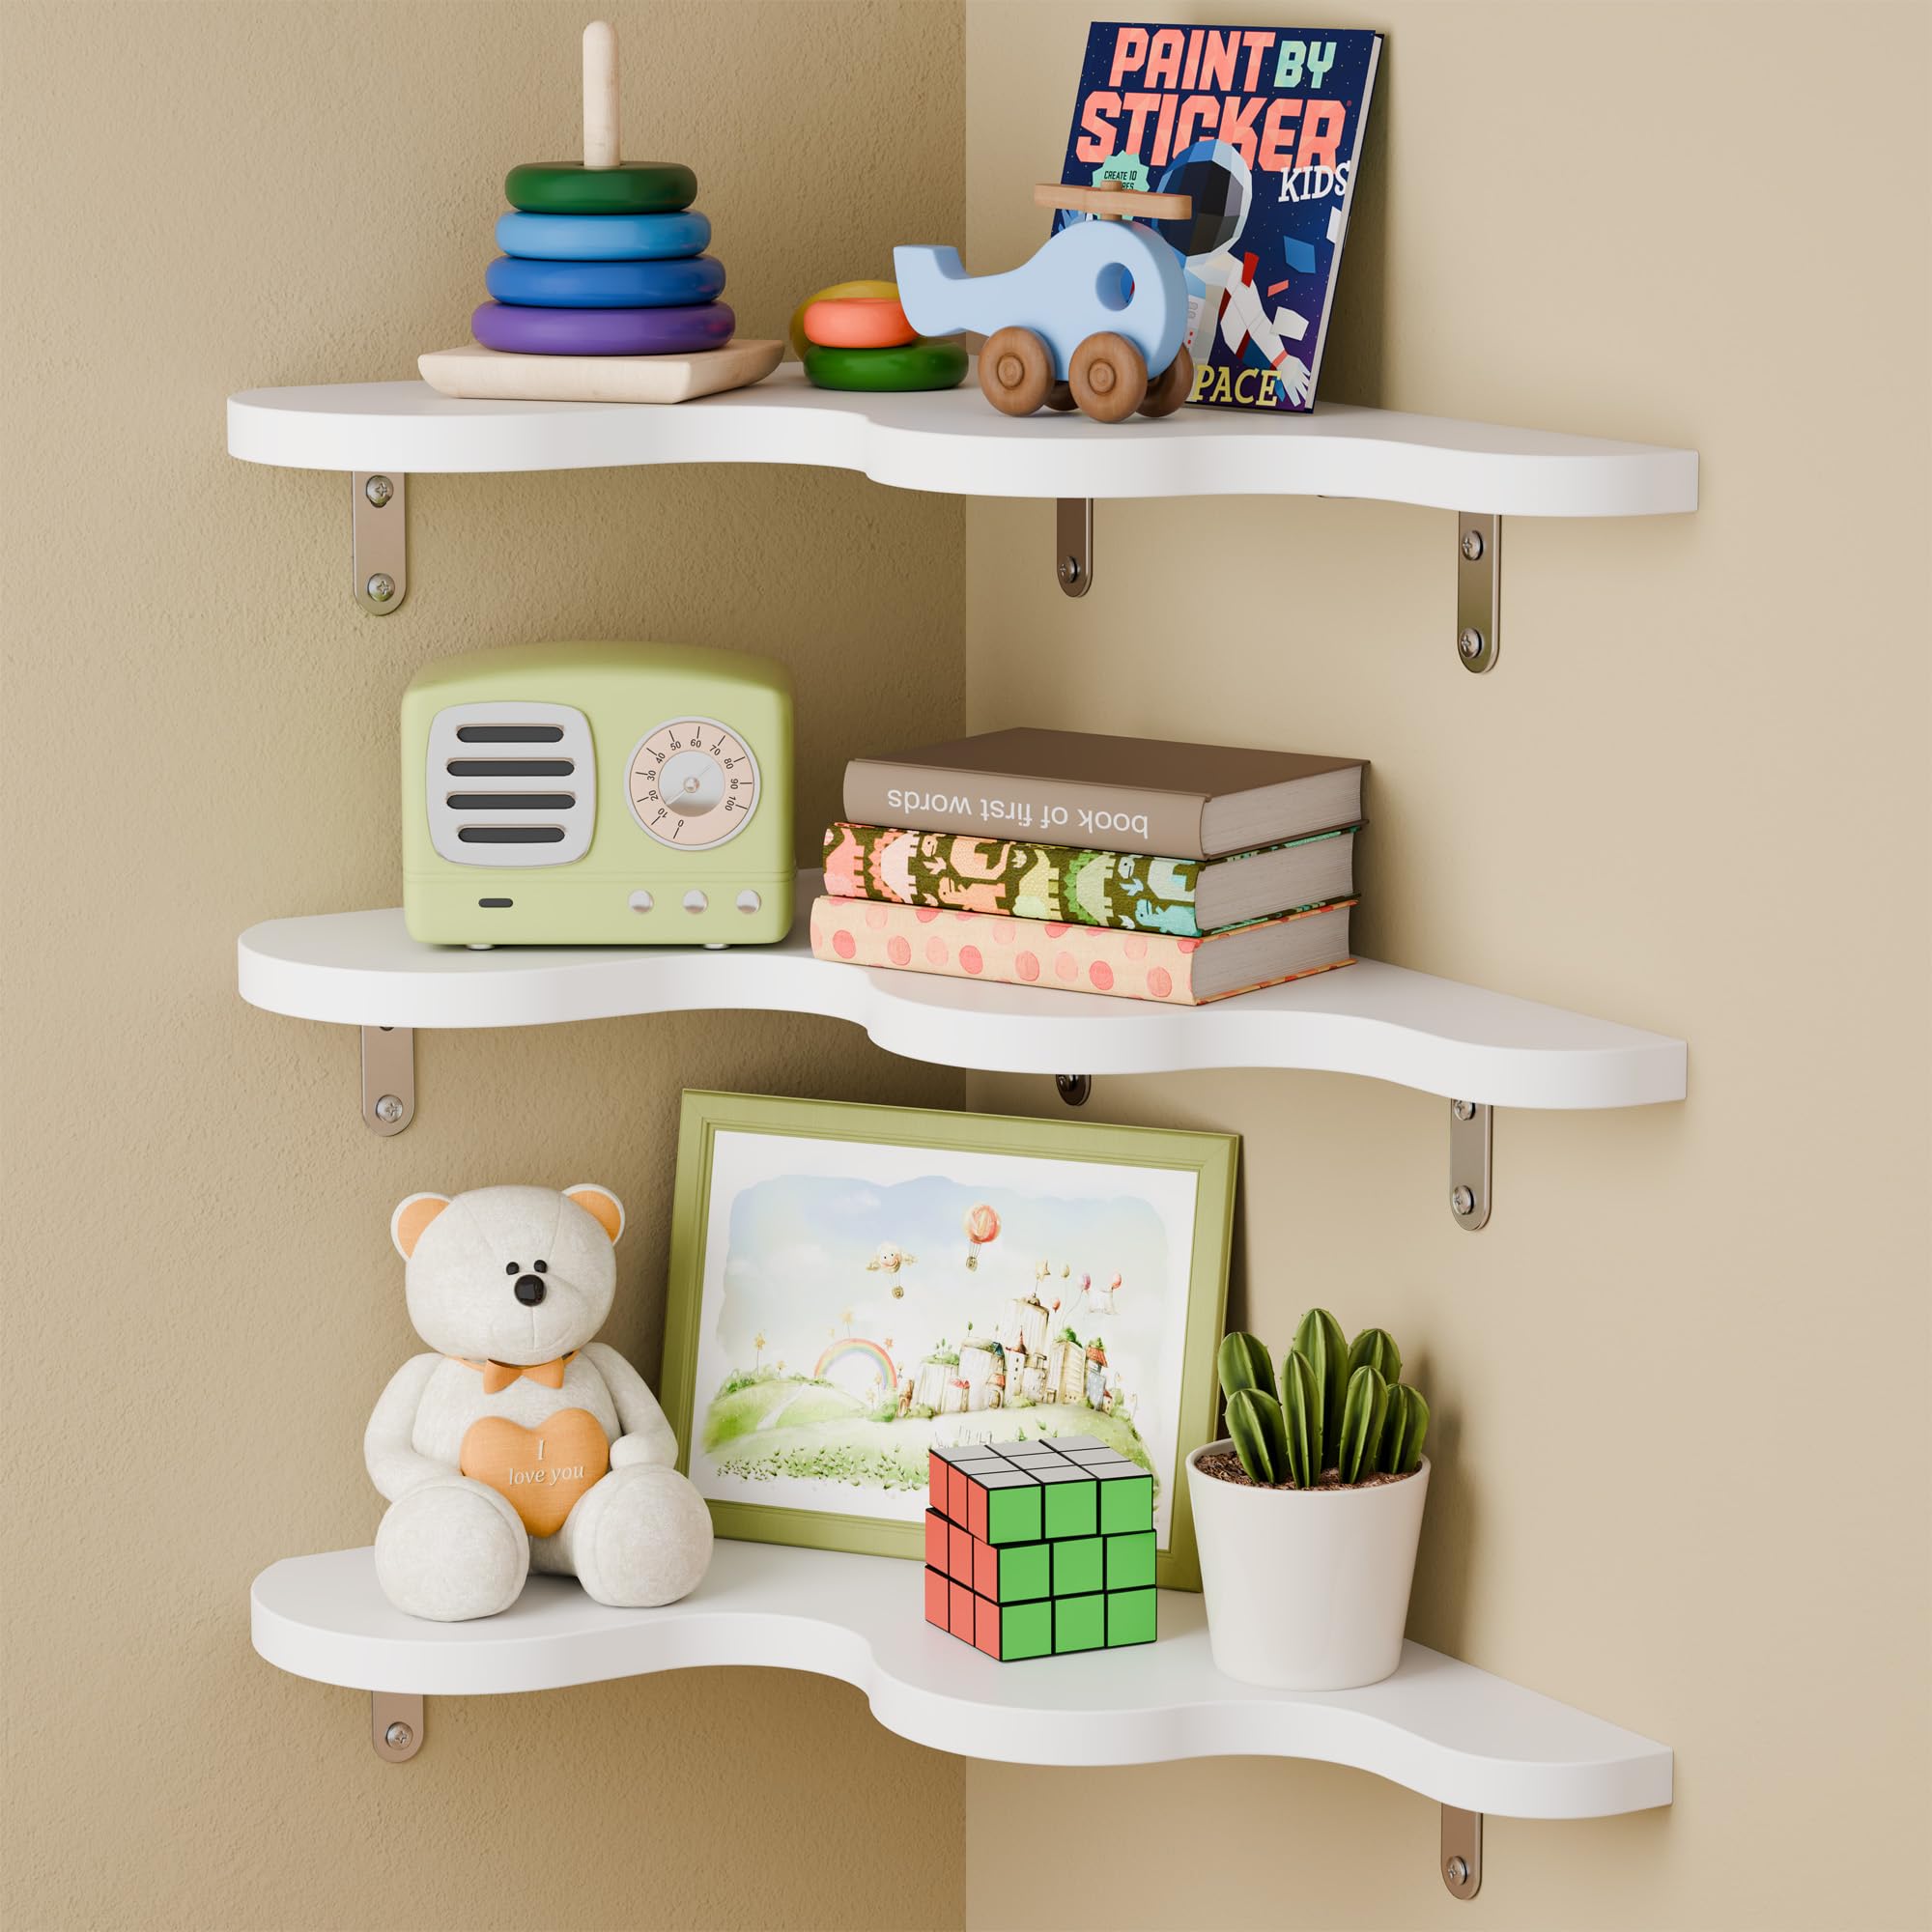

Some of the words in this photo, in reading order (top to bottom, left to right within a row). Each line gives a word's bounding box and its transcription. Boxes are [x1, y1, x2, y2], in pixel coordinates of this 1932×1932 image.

[1108, 27, 1276, 93] PAINT
[1273, 40, 1337, 89] BY
[1075, 91, 1347, 174] STICKER
[1104, 170, 1128, 181] CREATE
[1128, 170, 1138, 182] 10
[1278, 160, 1351, 203] KIDS
[1190, 364, 1283, 407] PACE
[670, 741, 681, 751] 50
[690, 739, 701, 748] 60
[709, 745, 721, 755] 70
[656, 753, 666, 764] 40
[724, 757, 733, 769] 80
[646, 770, 657, 781] 30
[730, 778, 739, 789] 90
[648, 790, 659, 801] 20
[887, 789, 973, 815] words
[724, 796, 736, 811] 100
[658, 808, 668, 818] 10
[980, 799, 1033, 827] first
[1039, 805, 1068, 829] of
[677, 819, 685, 828] 0
[1077, 809, 1149, 839] book
[537, 1439, 545, 1461] I
[509, 1467, 545, 1485] love
[549, 1465, 584, 1486] you
